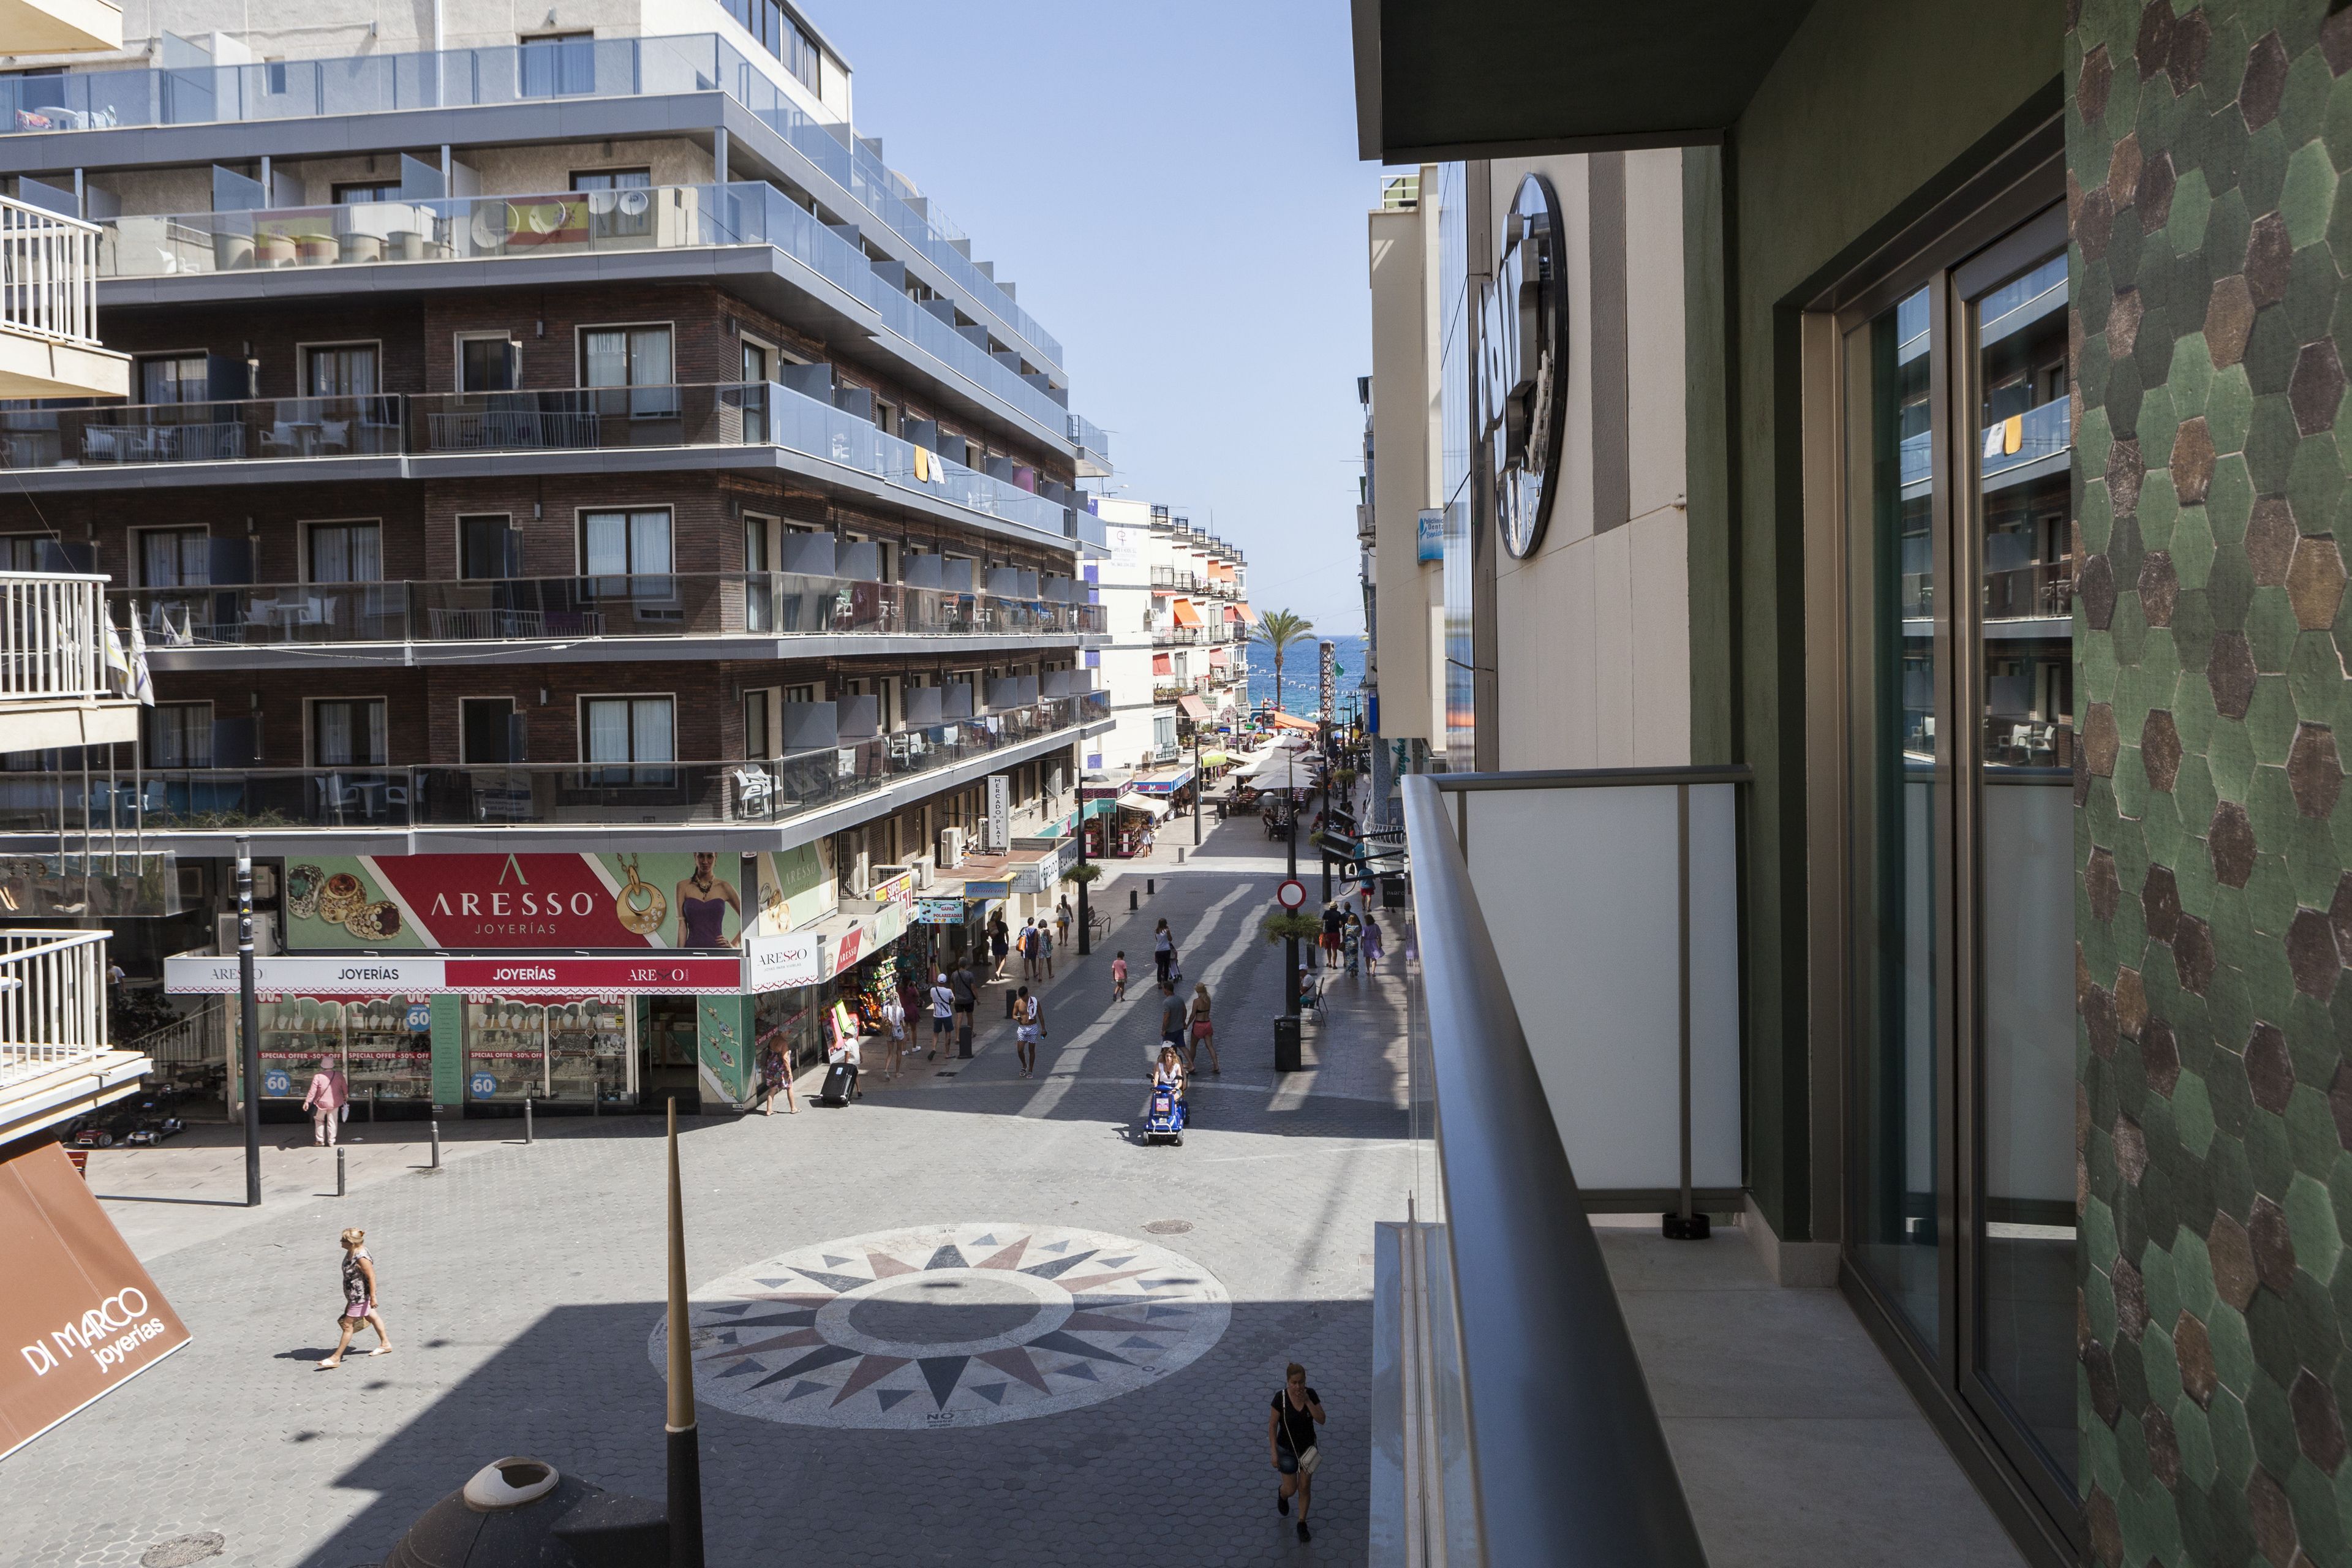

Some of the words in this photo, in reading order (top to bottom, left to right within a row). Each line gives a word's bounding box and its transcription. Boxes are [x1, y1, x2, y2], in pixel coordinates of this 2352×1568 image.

[785, 862, 816, 885] ARESSO
[1041, 860, 1058, 881] MERCADO
[1058, 856, 1063, 870] DE
[887, 881, 900, 898] SUPER
[431, 892, 593, 916] ARESSO
[475, 922, 556, 934] JOYERÍAS
[757, 949, 807, 967] ARESSO
[840, 946, 857, 963] ARESSO
[210, 968, 263, 981] AREO
[338, 966, 399, 980] JOYERÍAS
[493, 965, 556, 981] JOYERÍAS
[20, 1340, 59, 1376] DI
[51, 1287, 148, 1359] MARCO
[90, 1317, 165, 1374] joyerías
